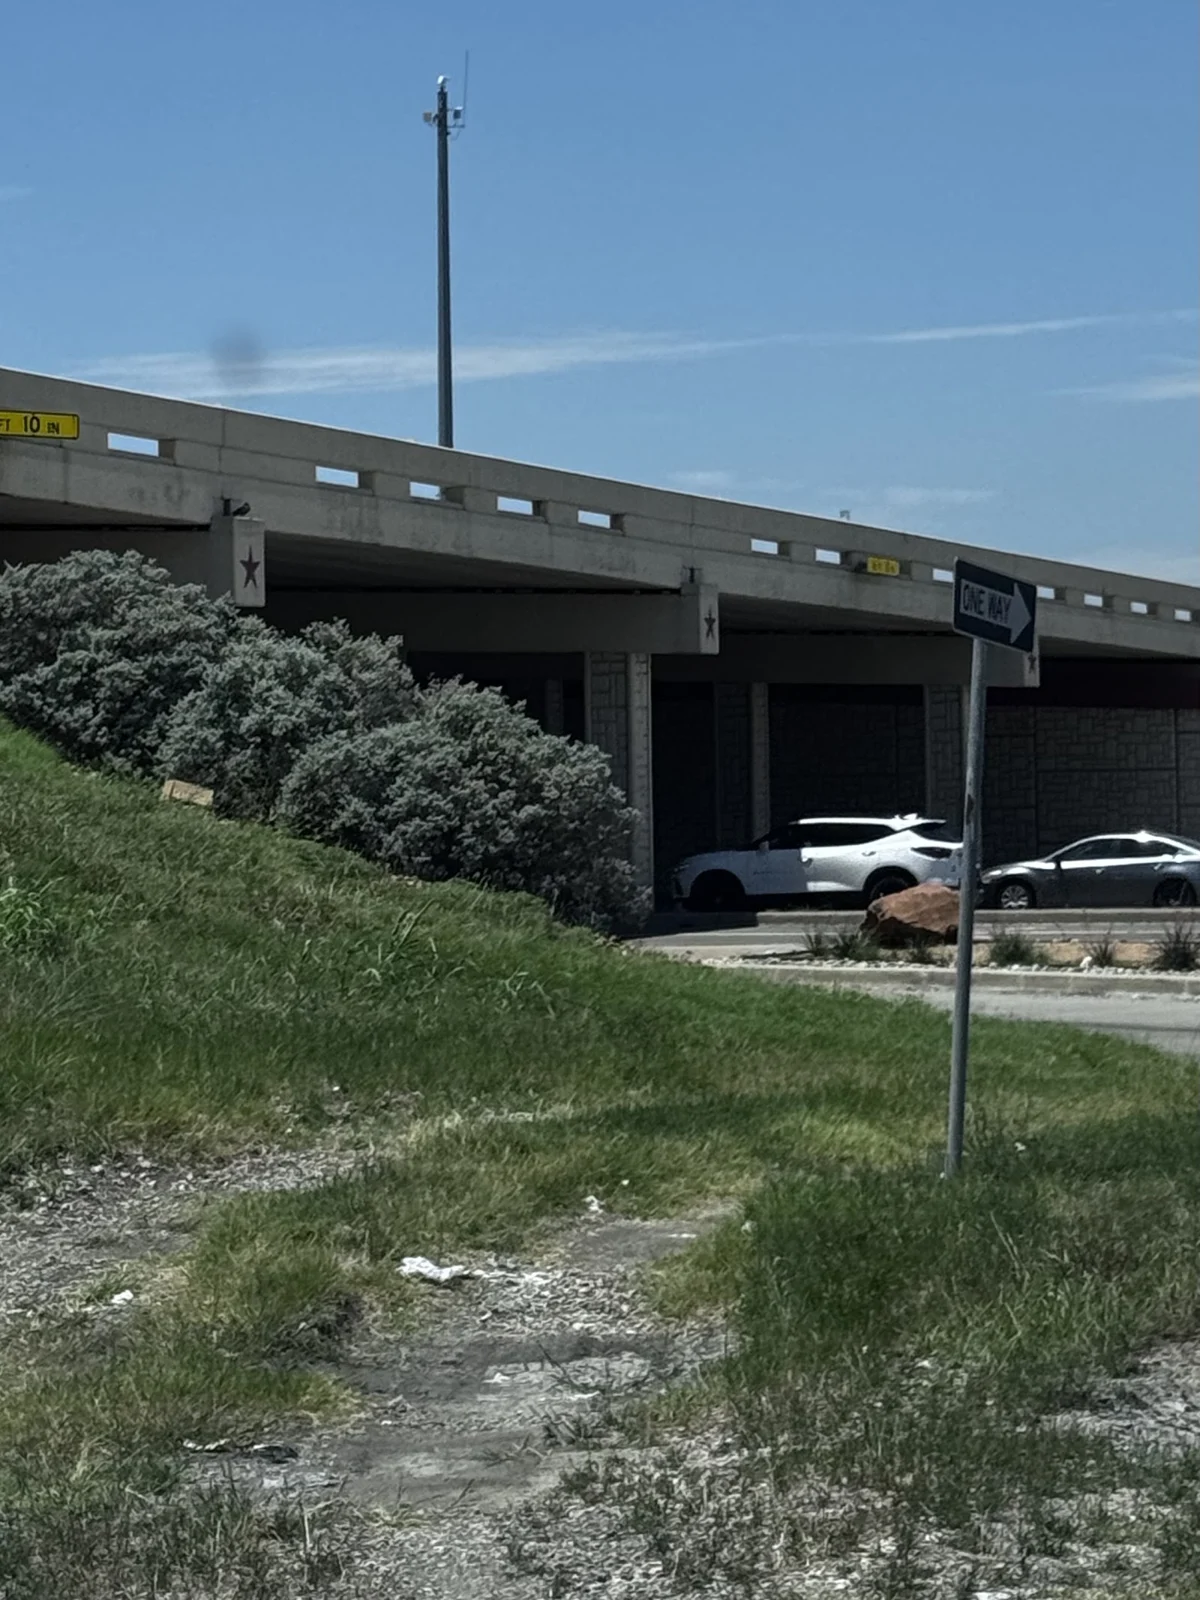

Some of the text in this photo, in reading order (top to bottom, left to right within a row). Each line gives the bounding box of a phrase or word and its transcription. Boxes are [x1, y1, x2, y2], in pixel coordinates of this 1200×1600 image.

[23, 416, 41, 433] 10
[47, 422, 60, 435] IN
[963, 583, 1012, 625] ONE WAY
